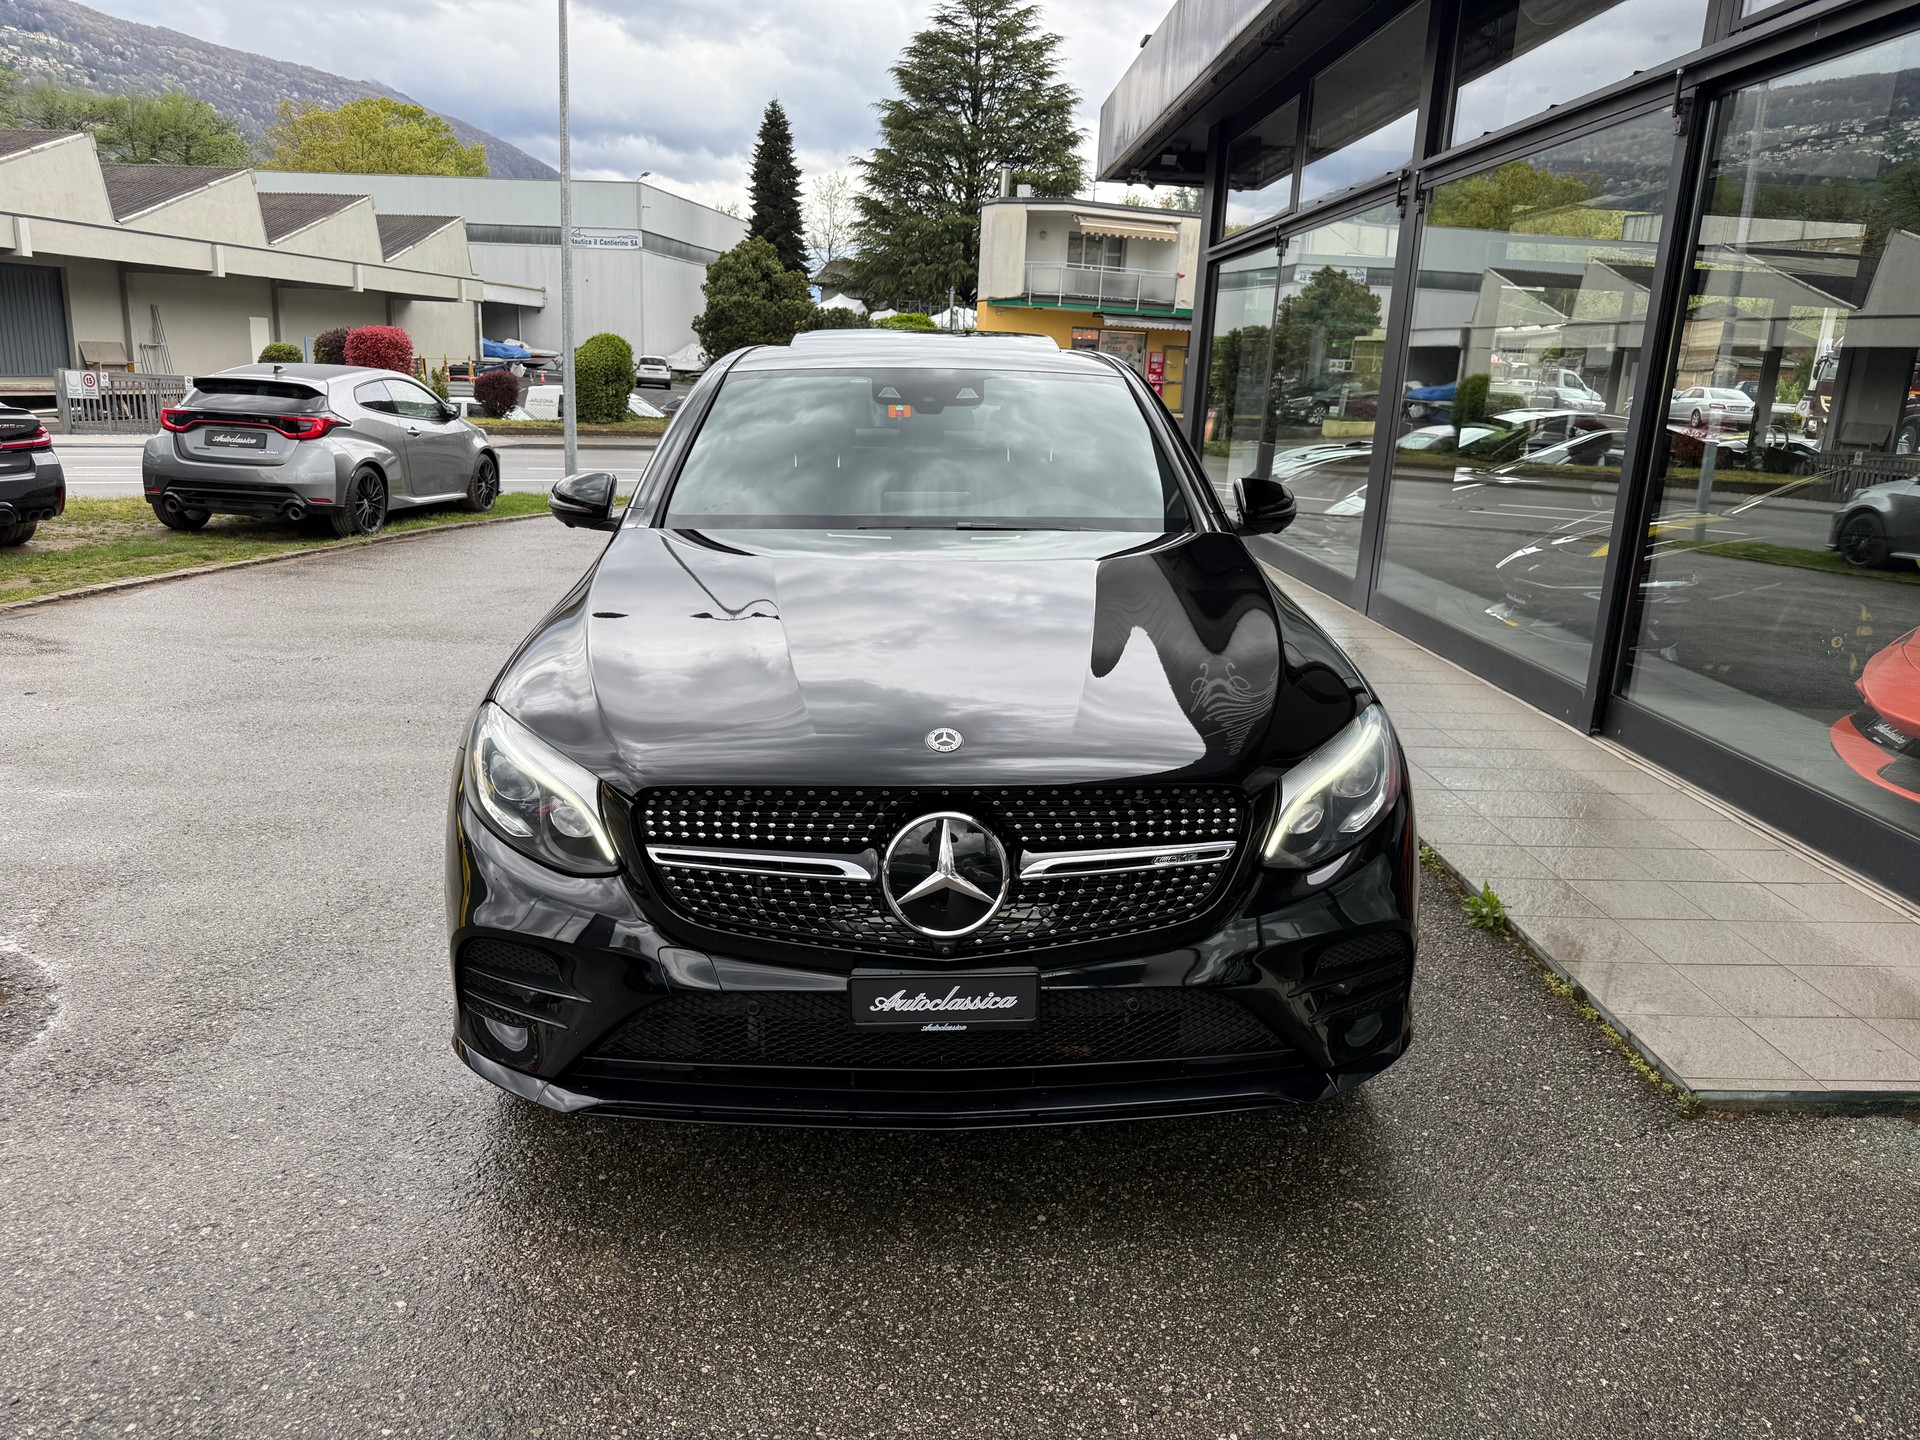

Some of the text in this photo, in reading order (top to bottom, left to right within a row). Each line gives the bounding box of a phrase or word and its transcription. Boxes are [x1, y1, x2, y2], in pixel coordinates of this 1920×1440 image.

[600, 239, 629, 247] Cantierino
[86, 377, 93, 385] 15
[212, 434, 257, 444] Autoclassica
[869, 985, 1018, 1012] Autoclassica
[920, 1023, 968, 1032] Autoclassica
